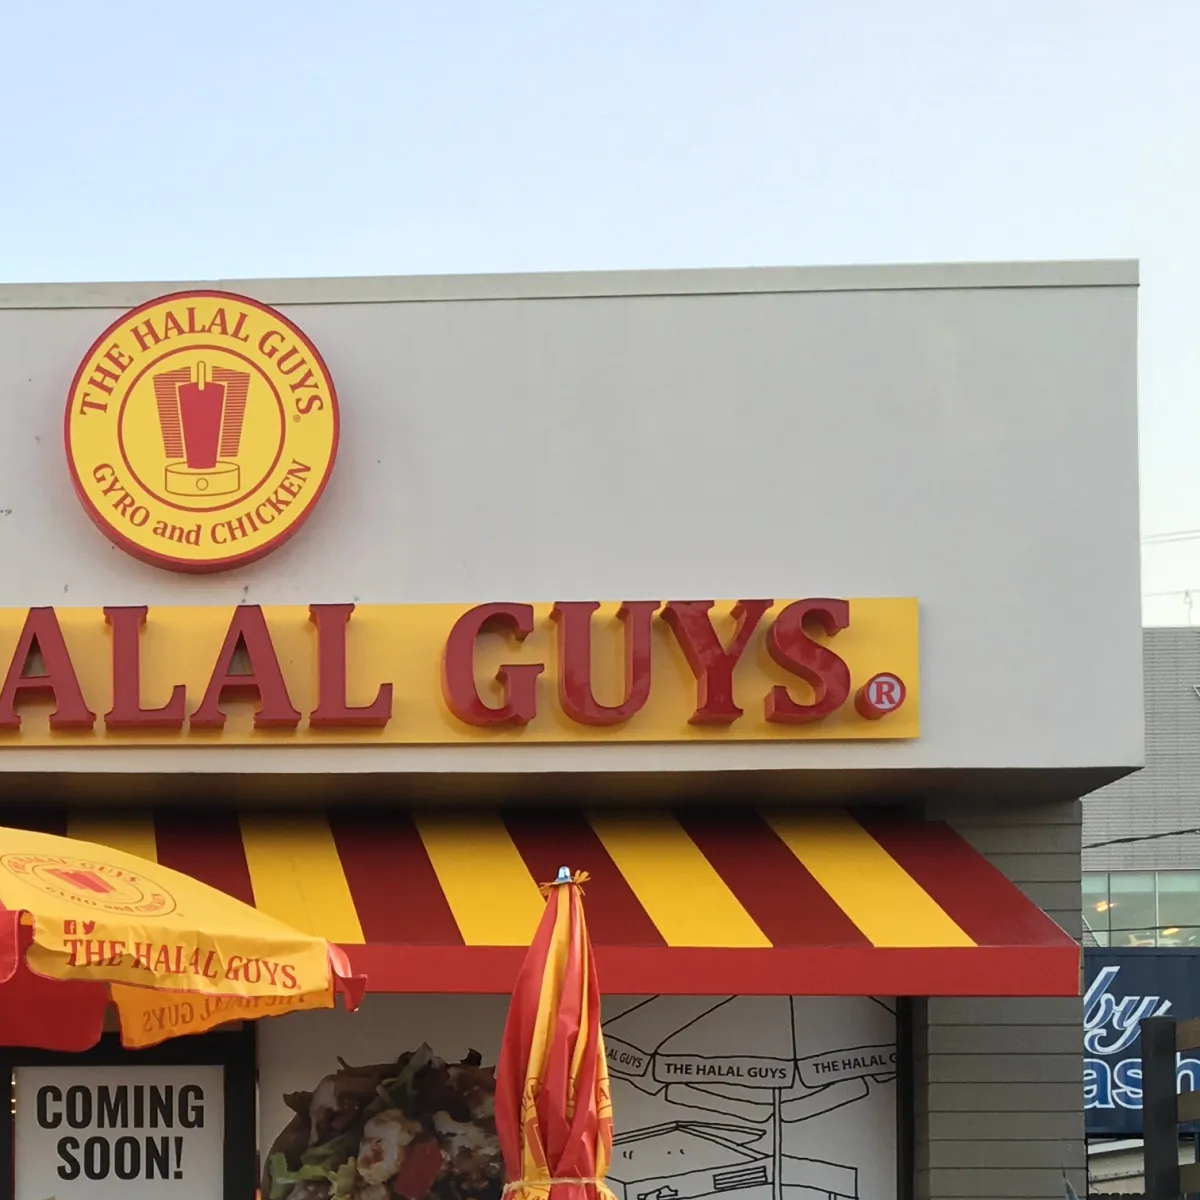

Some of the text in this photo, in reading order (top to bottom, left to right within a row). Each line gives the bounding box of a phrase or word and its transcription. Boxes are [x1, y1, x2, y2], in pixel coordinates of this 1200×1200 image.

[80, 307, 324, 416] THE HALAL GUYS
[92, 459, 312, 546] GYRO and CHICKEN
[442, 597, 851, 728] GUYS
[63, 939, 298, 990] THE HALAL GUYS
[1084, 966, 1172, 1055] by
[619, 1052, 643, 1068] GUYS
[665, 1063, 787, 1080] THE HALAL GUYS
[813, 1061, 840, 1074] THE
[842, 1054, 887, 1072] HALAL
[36, 1084, 205, 1130] COMING
[56, 1135, 184, 1181] SOON!
